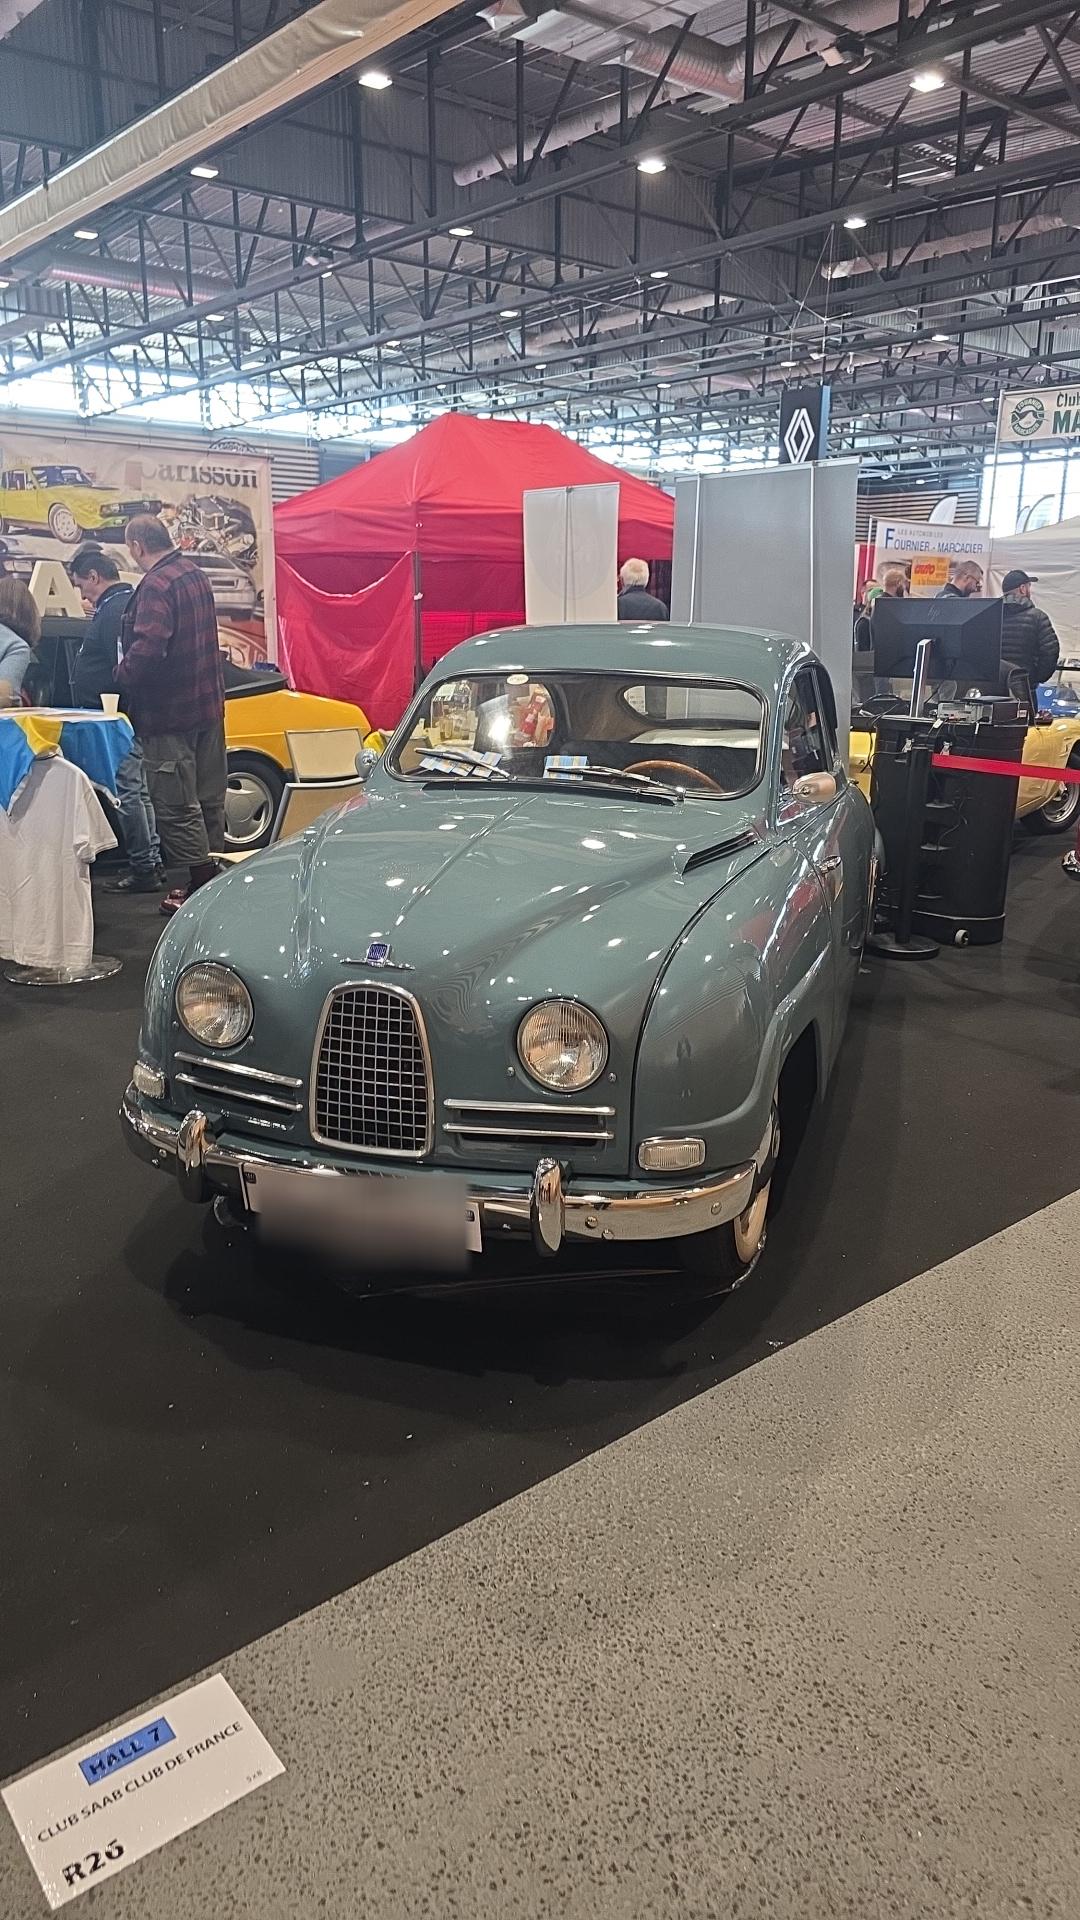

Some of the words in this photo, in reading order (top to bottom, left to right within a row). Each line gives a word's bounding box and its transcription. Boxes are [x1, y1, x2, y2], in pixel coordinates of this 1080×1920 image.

[884, 528, 930, 552] FOURNIER
[937, 542, 983, 554] MARCADIER
[89, 1741, 144, 1776] HALL
[148, 1727, 160, 1743] 7
[37, 1813, 79, 1842] CLUB
[81, 1789, 123, 1819] SAAB
[125, 1766, 164, 1794] CLUB
[165, 1754, 187, 1771] DE
[186, 1721, 244, 1760] FRANCE
[61, 1838, 125, 1887] R26
